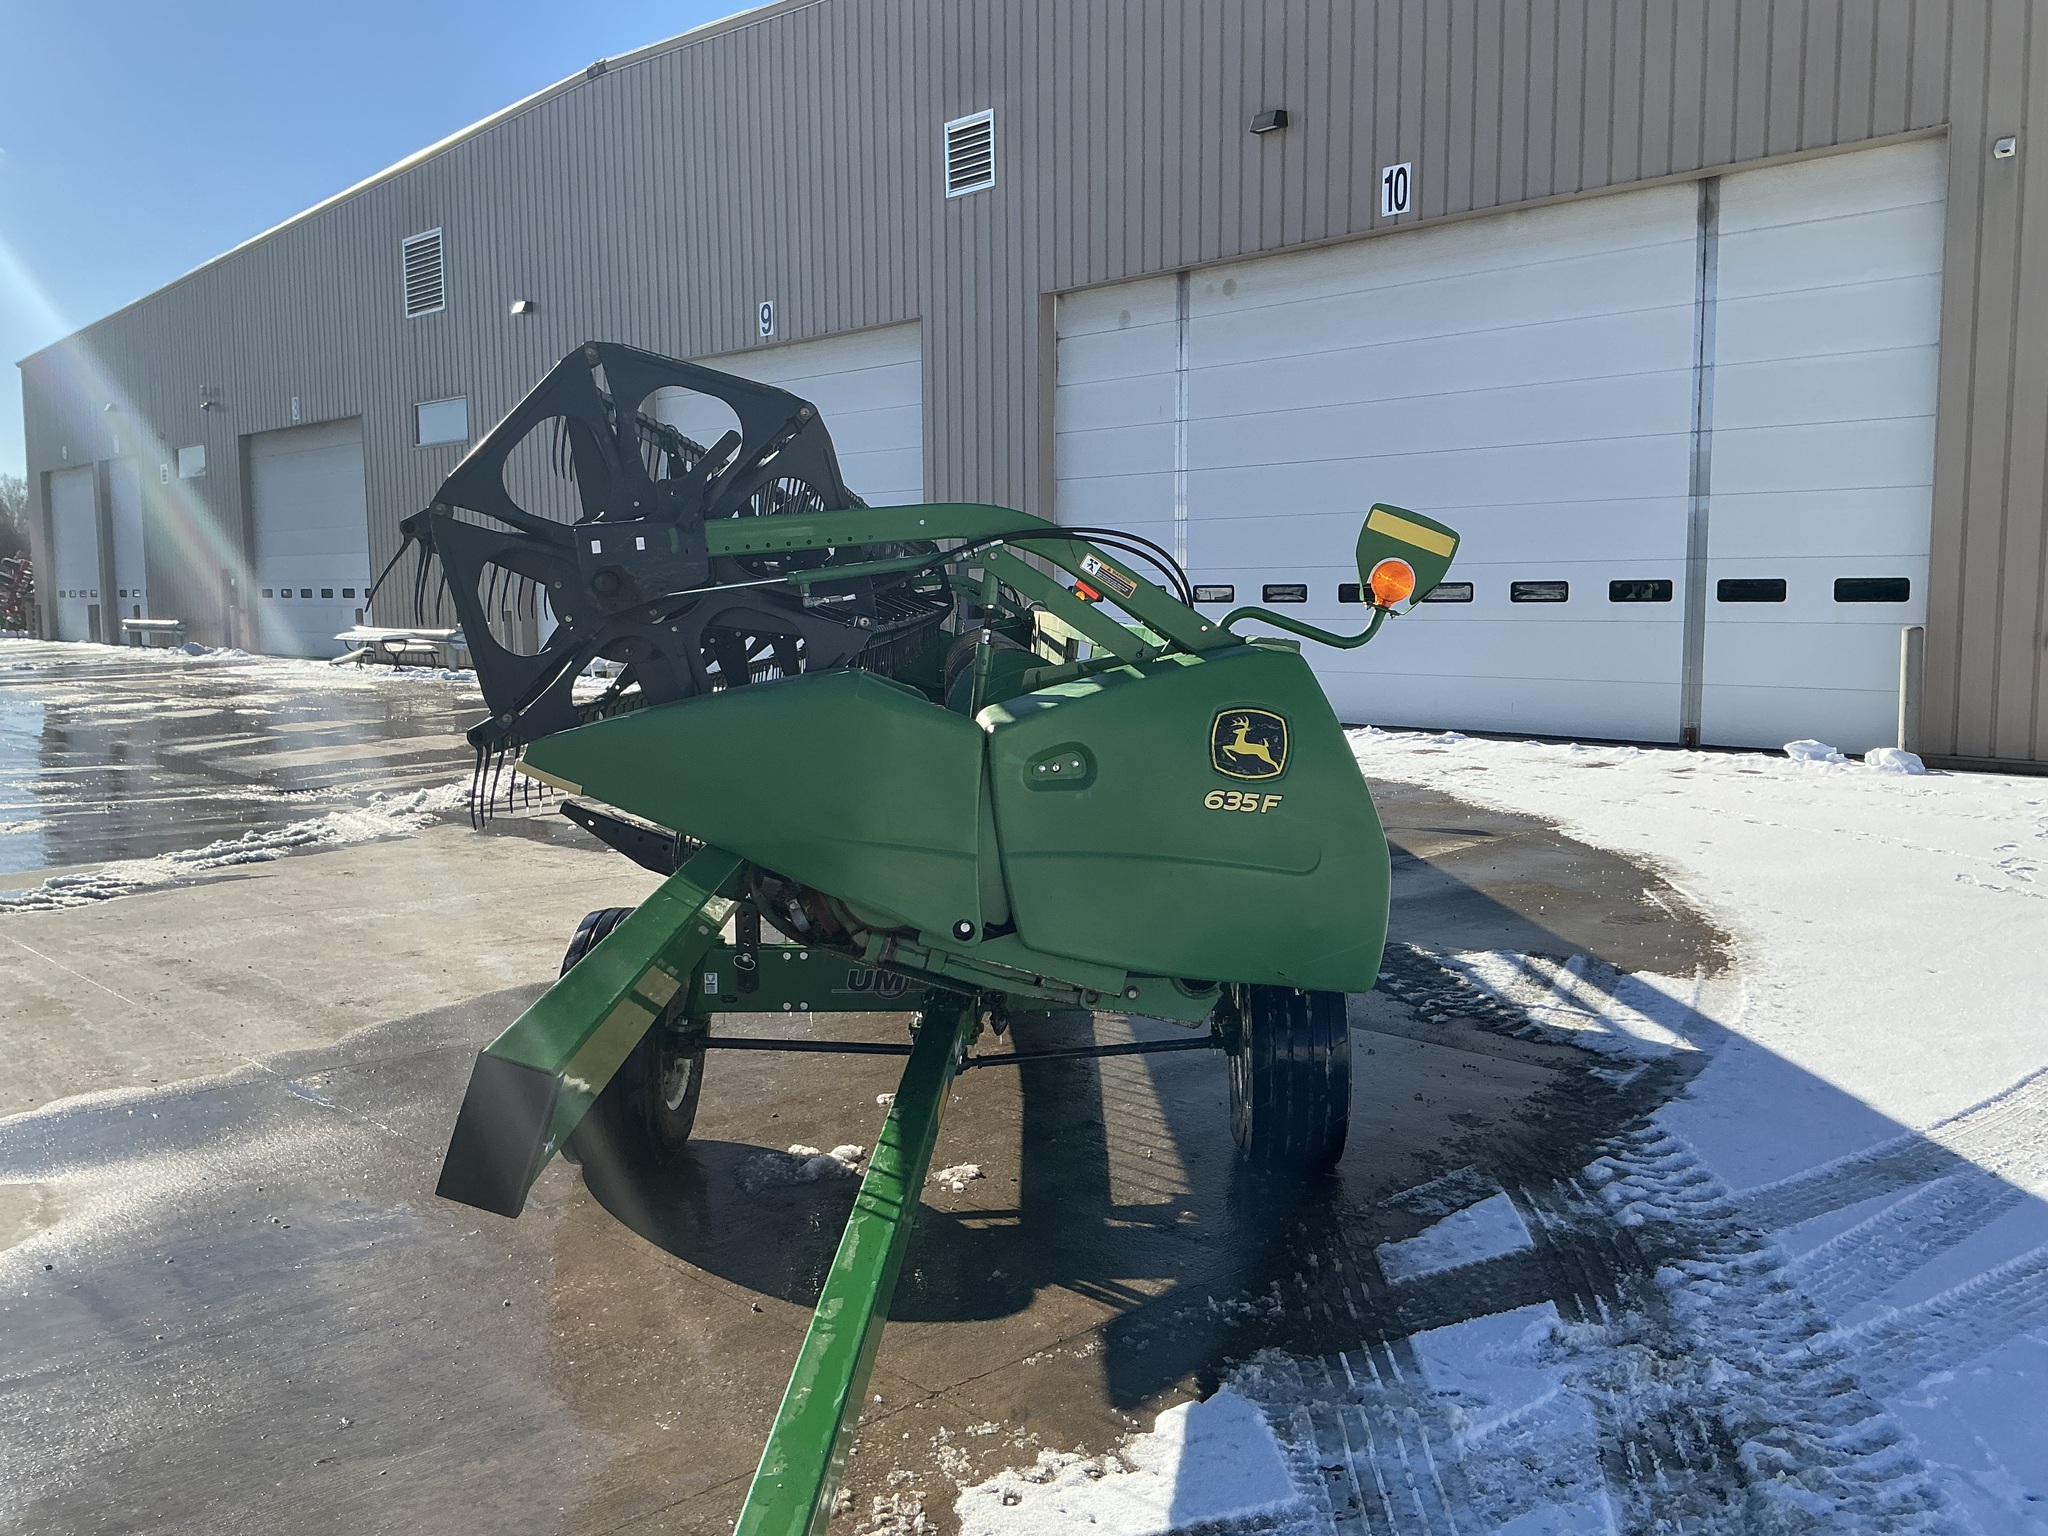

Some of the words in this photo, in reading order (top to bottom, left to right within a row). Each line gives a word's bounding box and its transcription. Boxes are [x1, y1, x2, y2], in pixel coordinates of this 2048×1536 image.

[1384, 166, 1408, 212] 10
[761, 303, 771, 334] 9
[1203, 789, 1283, 814] 635F
